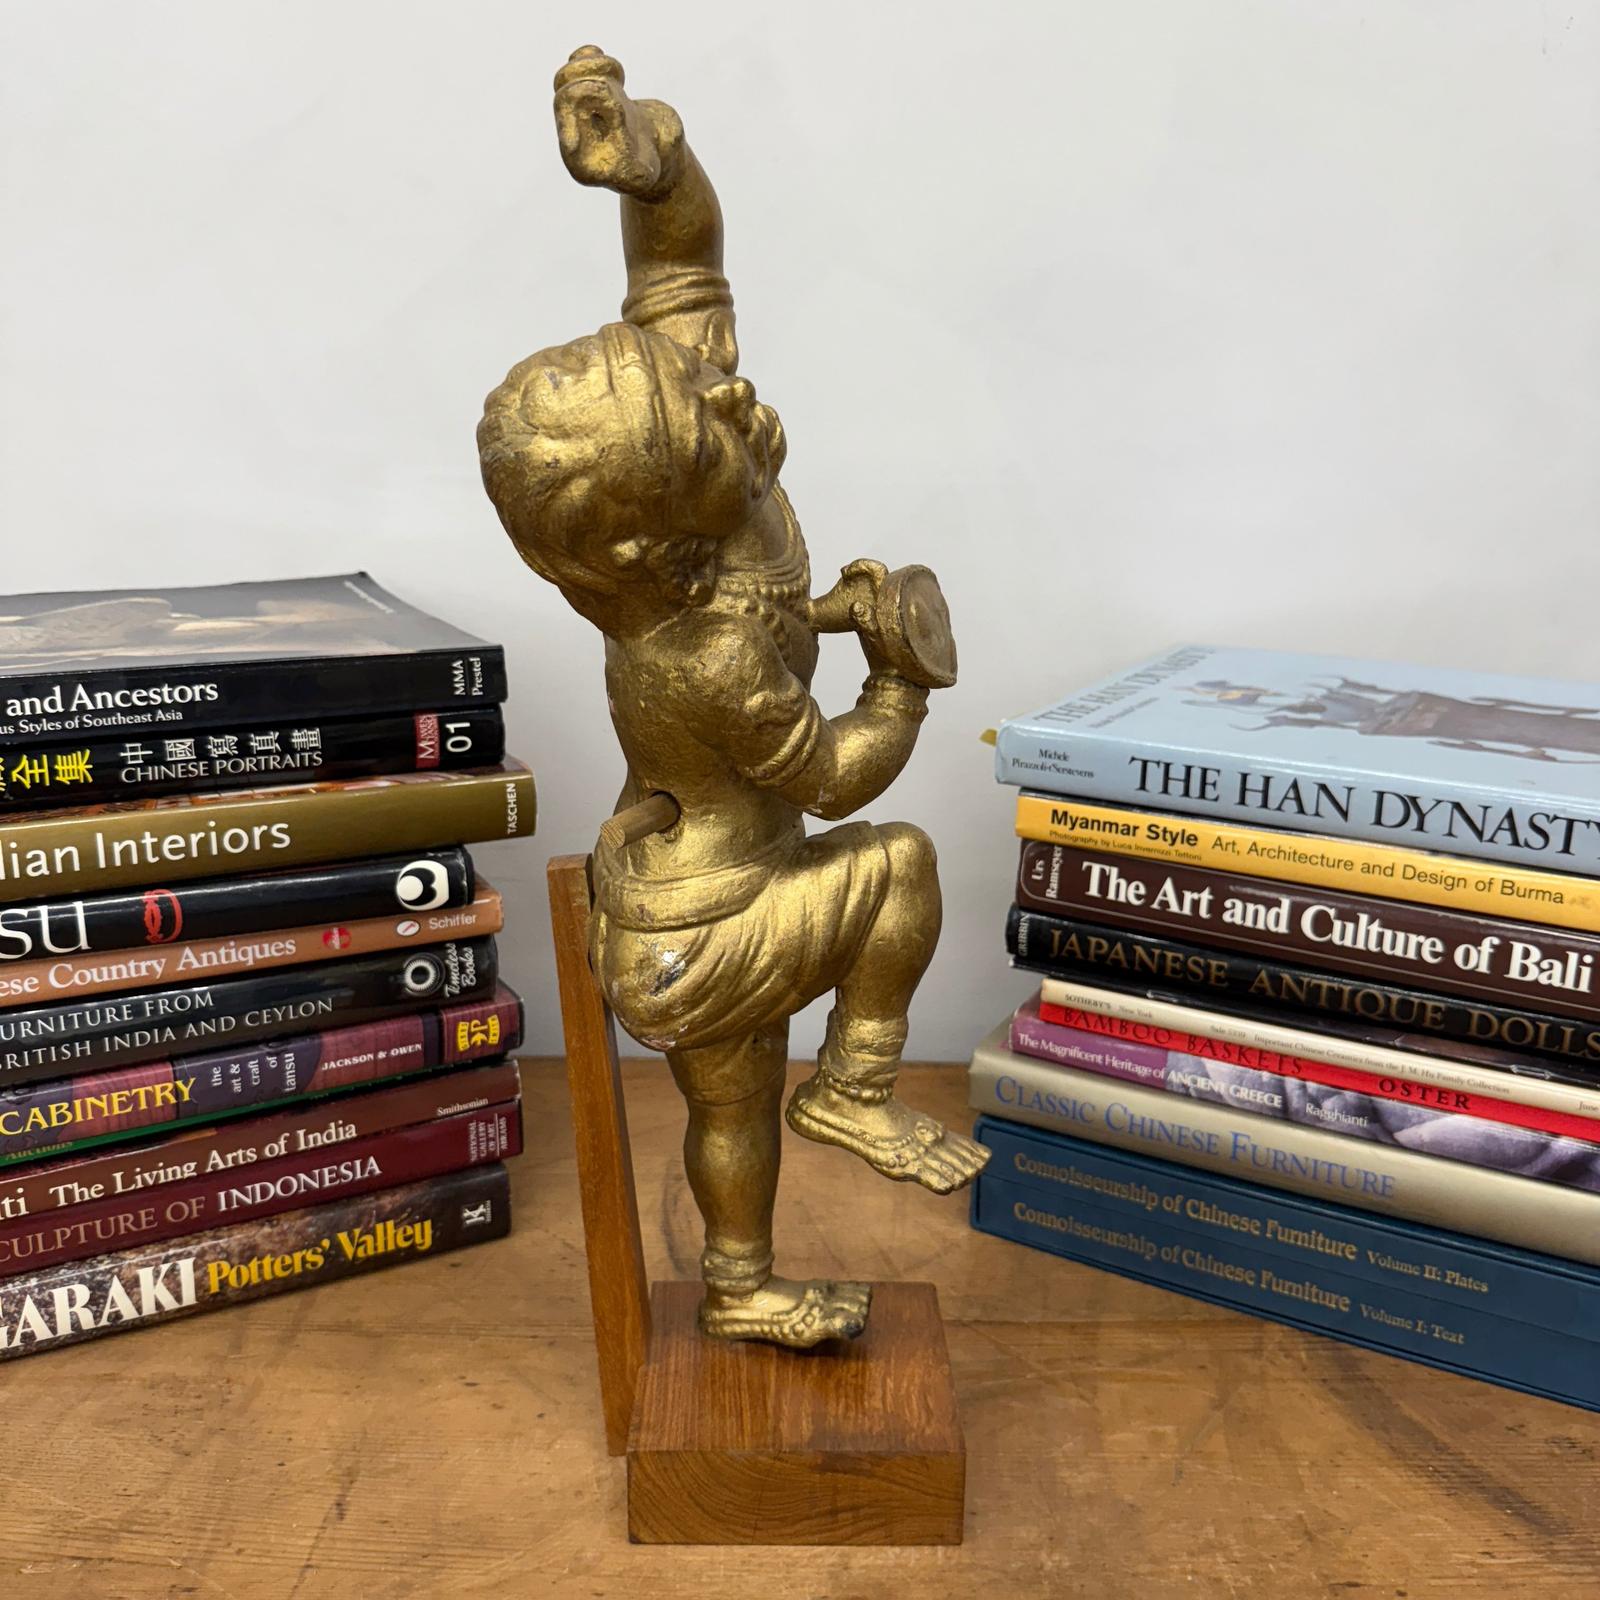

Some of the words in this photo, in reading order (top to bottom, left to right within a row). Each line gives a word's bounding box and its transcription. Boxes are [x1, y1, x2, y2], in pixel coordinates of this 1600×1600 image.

[454, 659, 466, 696] MMA
[471, 657, 484, 696] Prestel
[6, 684, 64, 717] and
[70, 682, 219, 712] Ancestors
[19, 716, 62, 735] Styles
[65, 713, 80, 730] of
[85, 711, 153, 728] Southeast
[155, 709, 183, 723] Asia
[446, 721, 472, 753] 01
[121, 760, 209, 784] CHINESE
[215, 751, 323, 775] PORTRAITS
[506, 783, 518, 834] TASCHEN
[1128, 756, 1221, 803] THE
[1234, 772, 1356, 823] HAN
[96, 821, 291, 869] Interiors
[1050, 830, 1098, 845] Photography
[1051, 809, 1140, 838] Myanmar
[1146, 824, 1198, 847] Style
[1212, 836, 1241, 854] Art,
[1246, 841, 1355, 872] Architecture
[1360, 863, 1395, 878] and
[1402, 865, 1468, 891] Design
[1474, 877, 1494, 893] of
[1500, 879, 1565, 904] Burma
[1031, 859, 1046, 881] Urs
[1046, 846, 1063, 899] Ramseyer
[429, 913, 477, 931] Schiffer
[1017, 913, 1030, 957] GRIBBIN
[1082, 861, 1147, 906] The
[1150, 876, 1214, 920] Art
[1222, 897, 1292, 935] and
[1300, 904, 1445, 965] Culture
[1454, 936, 1500, 975] of
[1504, 940, 1595, 994] Bali
[48, 957, 167, 990] Country
[176, 938, 296, 971] Antiques
[461, 946, 477, 988] Books
[144, 991, 214, 1017] FROM
[1050, 928, 1231, 988] JAPANESE
[1249, 968, 1447, 1030] ANTIQUE
[1467, 1009, 1600, 1061] DOLLS
[0, 1039, 92, 1072] RITISH
[104, 1027, 177, 1052] INDIA
[185, 1014, 237, 1039] AND
[245, 997, 334, 1027] CEYLON
[211, 1066, 223, 1087] the
[248, 1057, 261, 1086] craft
[266, 1055, 278, 1068] of
[284, 1053, 296, 1092] tansu
[321, 1054, 376, 1071] JACKSON
[378, 1050, 387, 1060] &
[390, 1043, 423, 1058] OWEN
[1018, 1032, 1039, 1049] The
[1040, 1039, 1103, 1065] Magnificent
[1105, 1055, 1152, 1079] Heritage
[1152, 1067, 1168, 1080] of
[1167, 1070, 1227, 1095] ANCIENT
[1229, 1084, 1283, 1109] GREECE
[1063, 1007, 1172, 1046] BAMBOO
[1187, 1034, 1303, 1075] BASKETS
[1379, 1077, 1472, 1111] OSTER
[0, 1077, 197, 1137] CABINETRY
[232, 1077, 242, 1094] art
[437, 1097, 489, 1117] Smithsonian
[50, 1181, 105, 1208] The
[112, 1161, 198, 1195] Living
[205, 1146, 258, 1174] Arts
[264, 1133, 290, 1159] of
[296, 1120, 358, 1151] India
[165, 1196, 206, 1224] OF
[217, 1155, 382, 1212] INDONESIA
[1014, 1152, 1159, 1212] Connoisseurship
[1162, 1195, 1184, 1213] of
[1185, 1198, 1260, 1236] Chinese
[1265, 1218, 1358, 1260] Furniture
[1366, 1250, 1421, 1276] Volume
[1445, 1270, 1489, 1294] Plates
[207, 1237, 331, 1295] Potters'
[337, 1218, 433, 1259] Valley
[1014, 1202, 1158, 1261] Connoisseurship
[1161, 1245, 1183, 1264] of
[1182, 1249, 1256, 1287] Chinese
[1260, 1269, 1351, 1313] Furniture
[1359, 1303, 1413, 1331] Volume
[1431, 1323, 1465, 1345] Text
